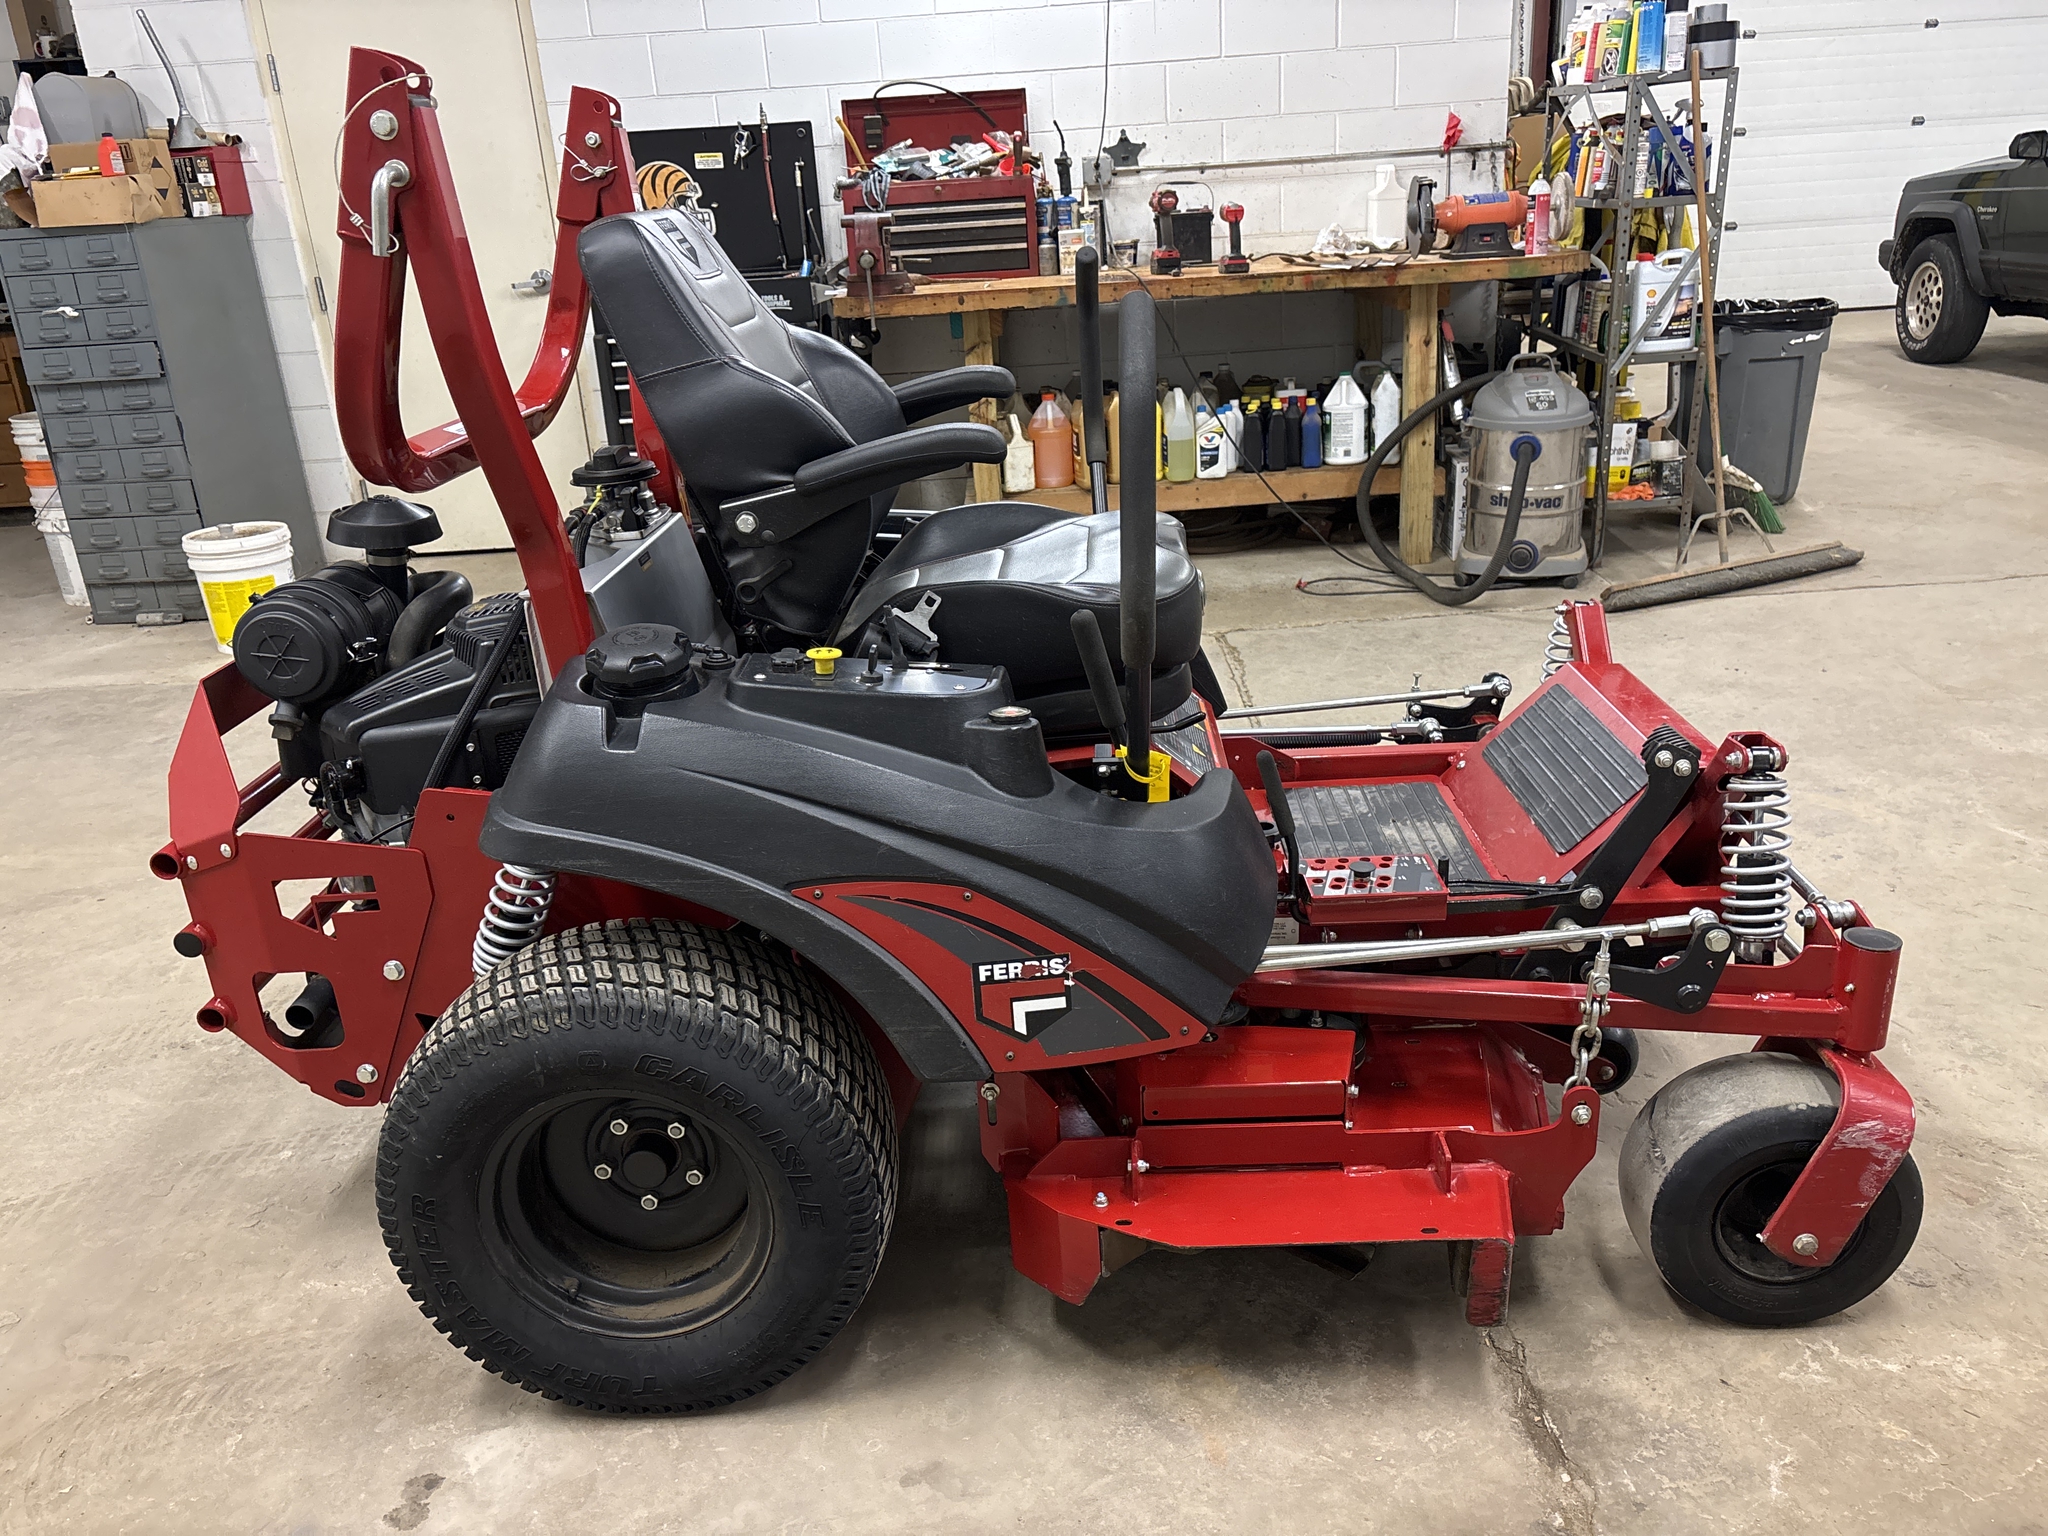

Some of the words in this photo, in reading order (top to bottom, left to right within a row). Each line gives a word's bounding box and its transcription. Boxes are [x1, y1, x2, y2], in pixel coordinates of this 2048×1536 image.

[764, 299, 791, 307] QUIPMENT
[633, 1051, 826, 1230] CARLISLE
[411, 1192, 534, 1368] MASTER
[530, 1358, 663, 1399] TURF
